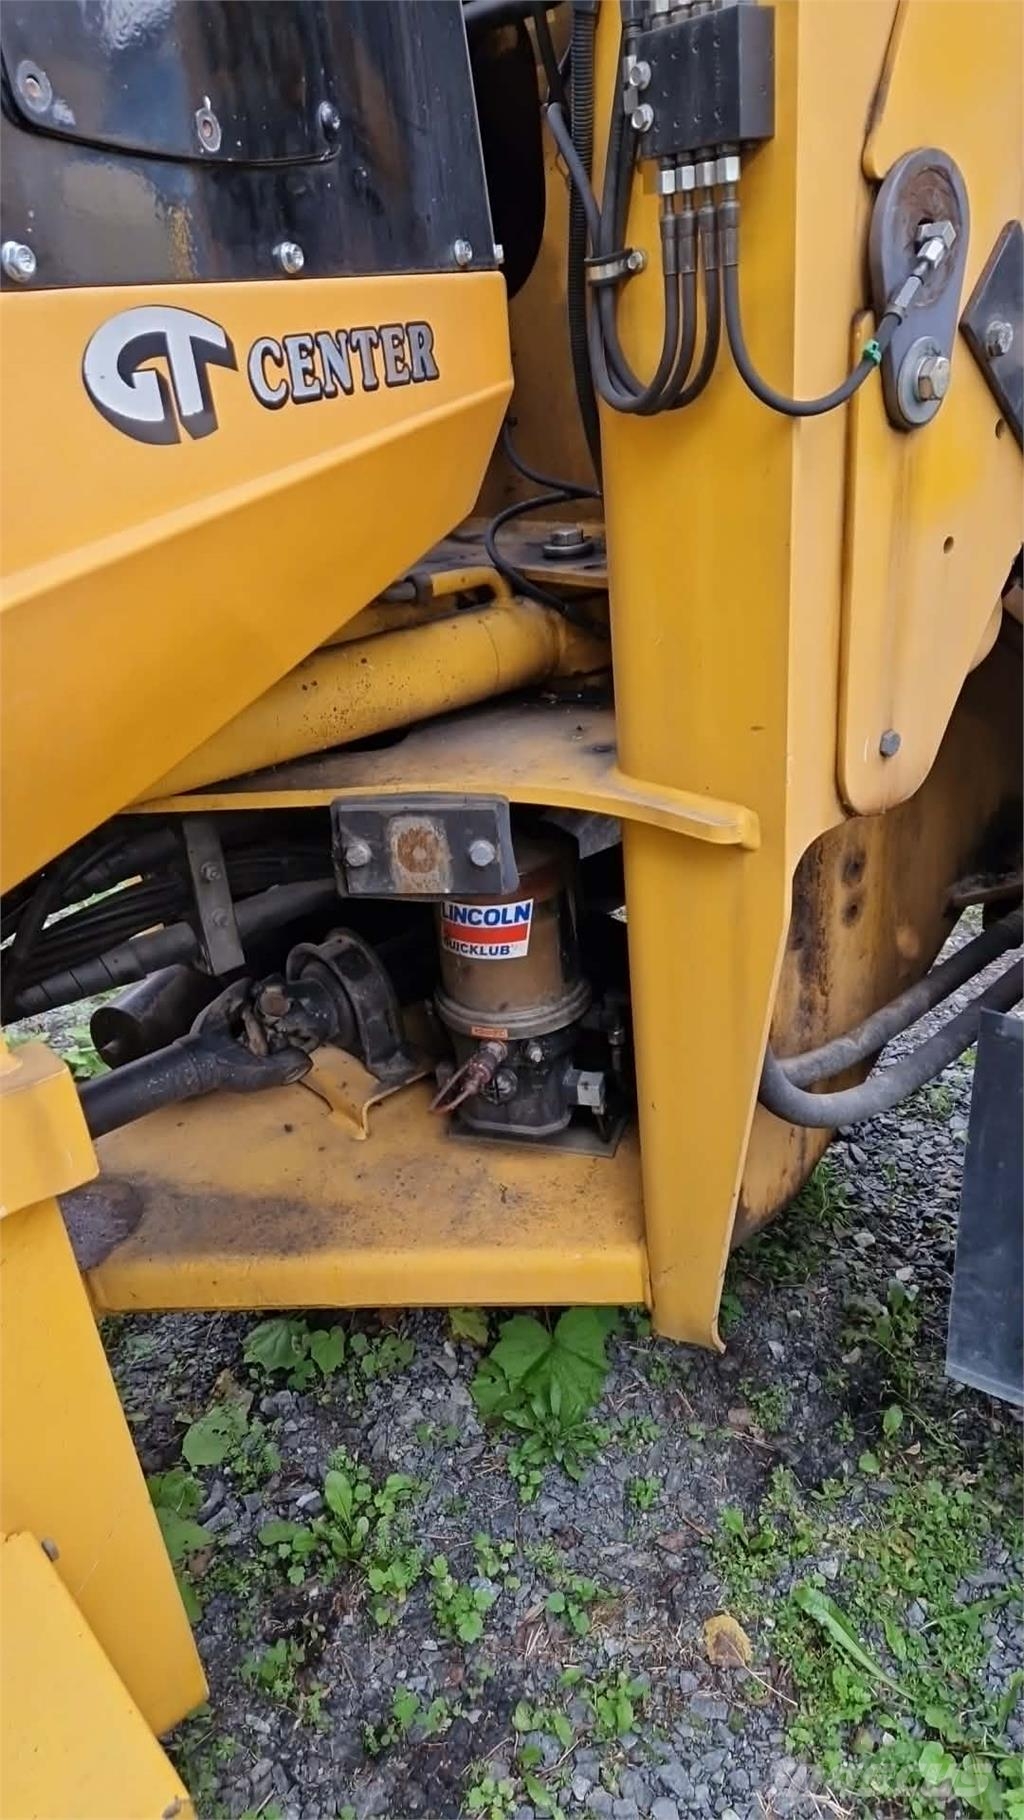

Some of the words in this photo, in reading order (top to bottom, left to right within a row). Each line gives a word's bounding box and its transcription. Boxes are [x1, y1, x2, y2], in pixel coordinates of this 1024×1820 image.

[82, 304, 238, 444] GT
[248, 320, 439, 410] CENTER
[442, 902, 531, 925] LINCOLN
